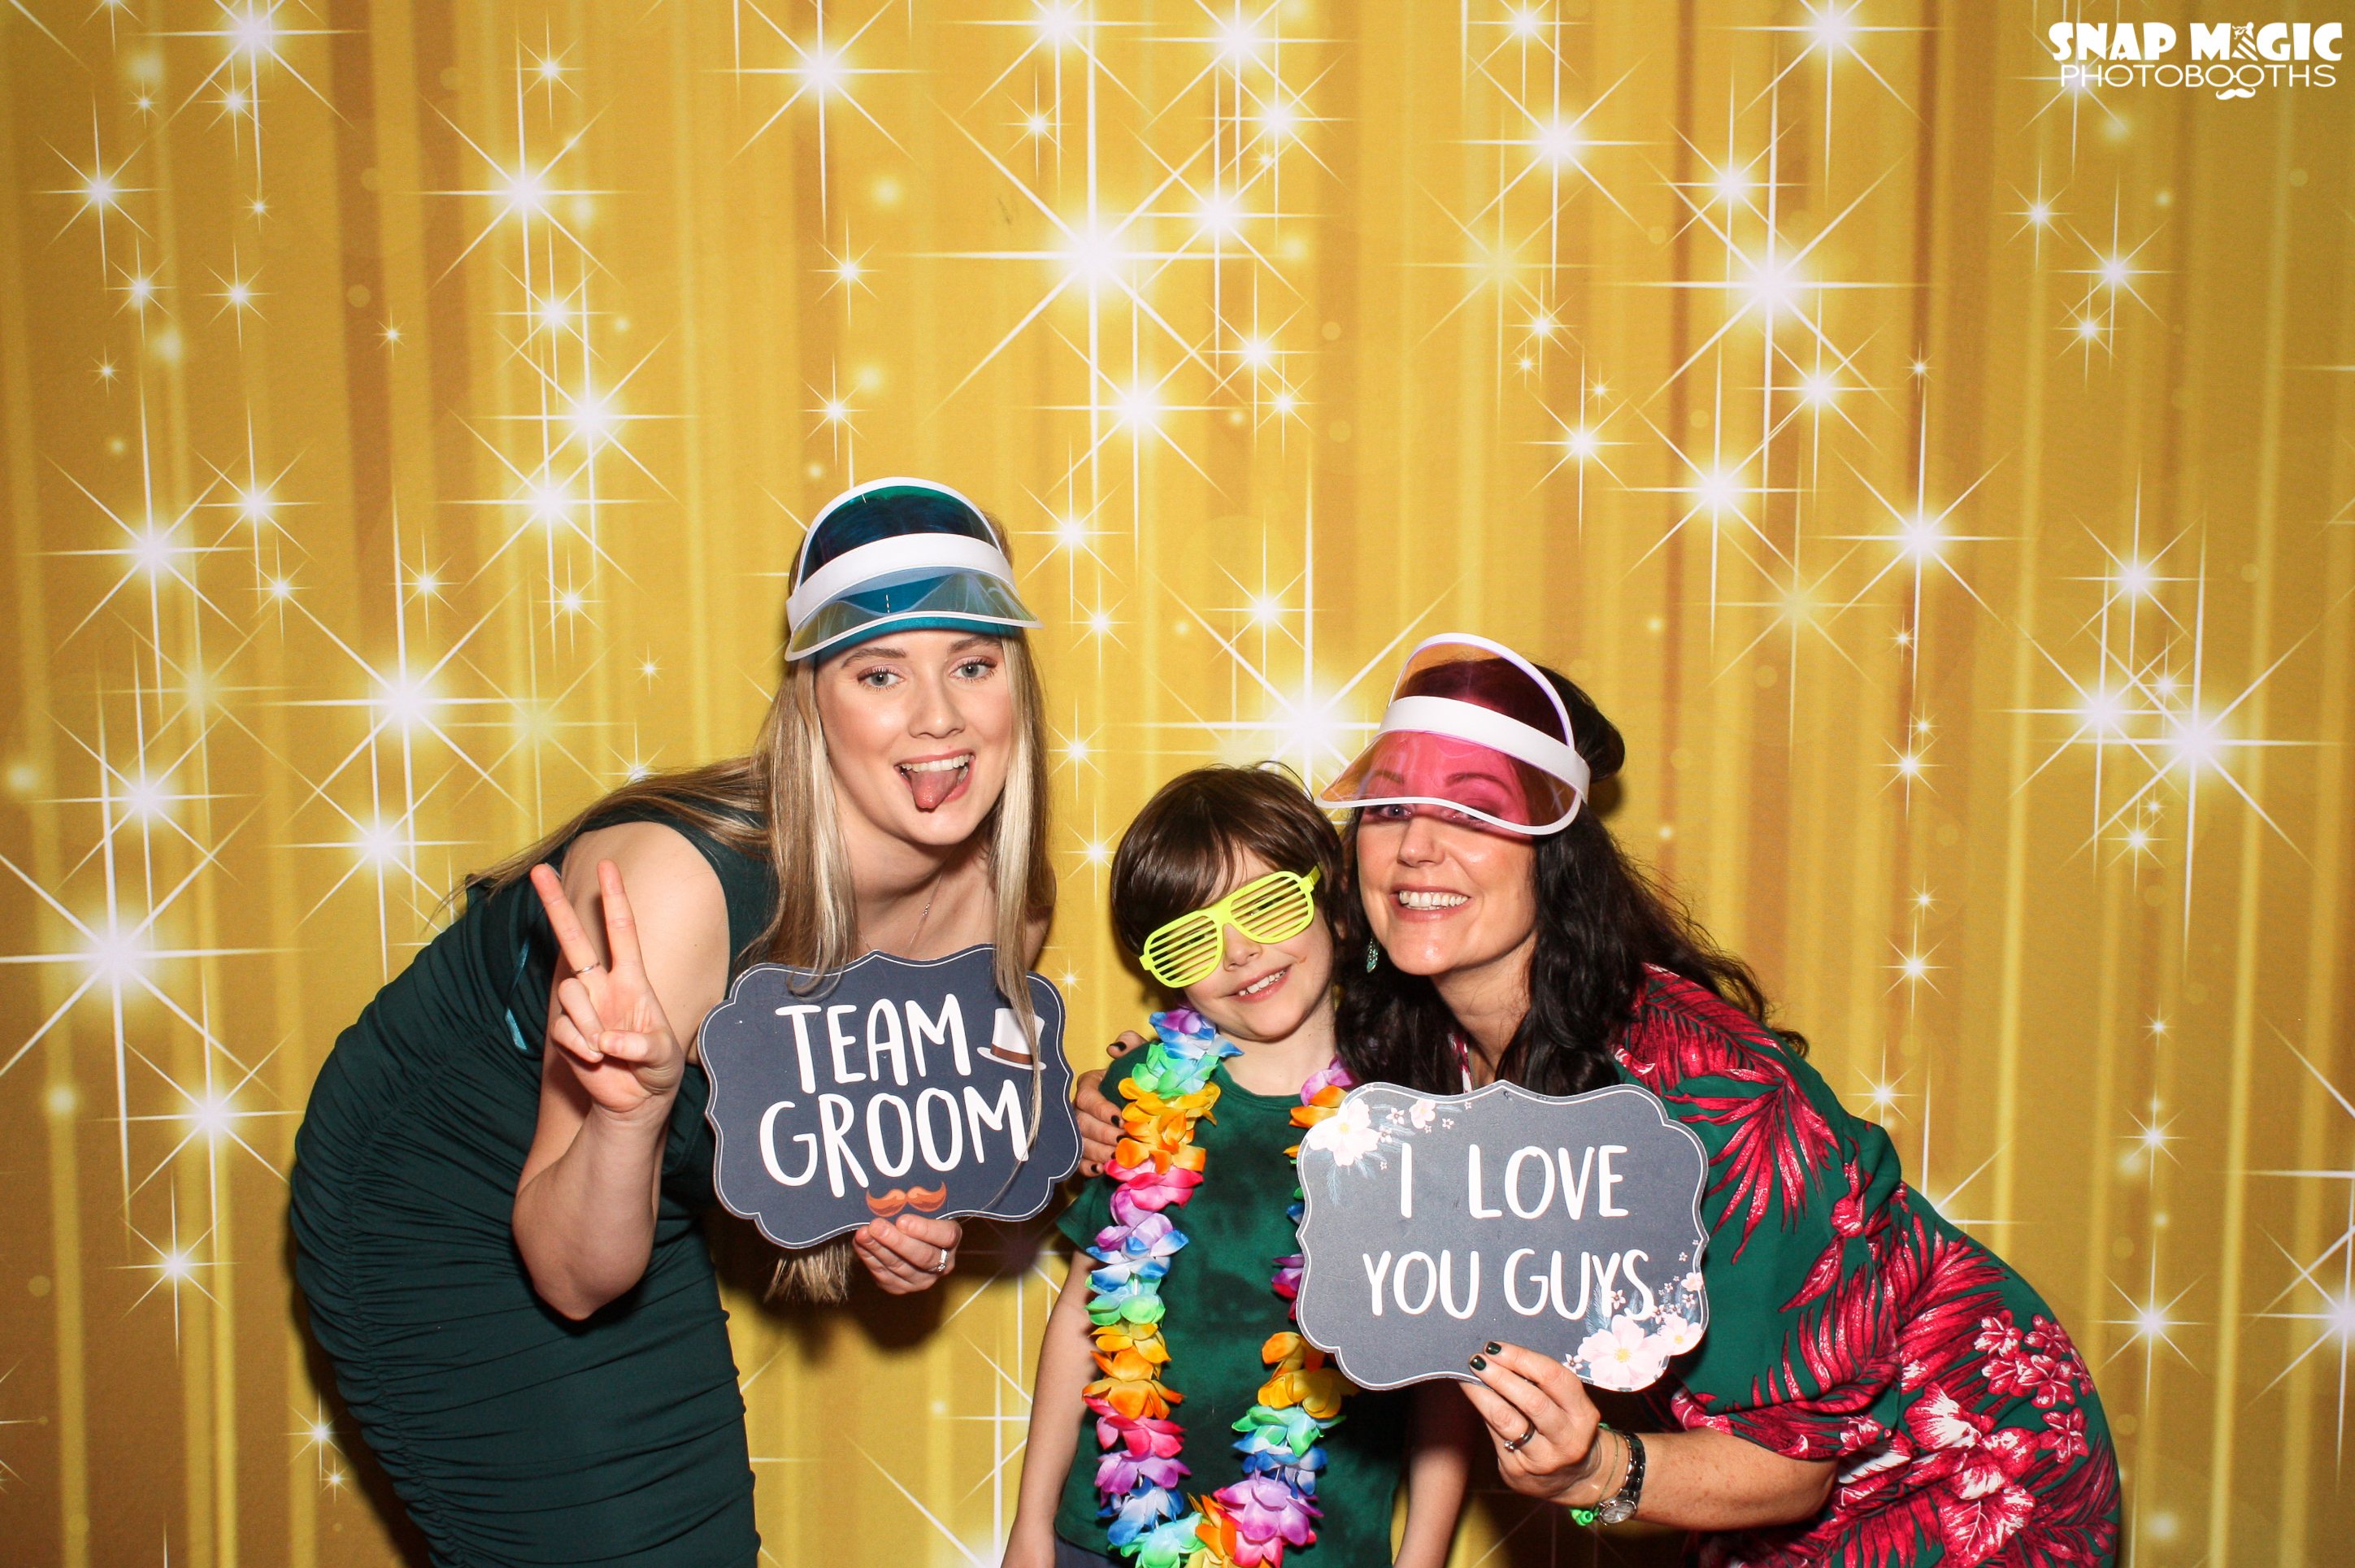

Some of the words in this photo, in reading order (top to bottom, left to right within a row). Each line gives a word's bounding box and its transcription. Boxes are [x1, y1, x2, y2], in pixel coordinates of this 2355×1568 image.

[775, 993, 971, 1094] TEAM
[759, 1079, 1029, 1197] GROOM
[1401, 1143, 1412, 1218] I
[1468, 1144, 1629, 1220] LOVE
[1362, 1249, 1479, 1319] YOU
[1503, 1248, 1654, 1321] GUYS
